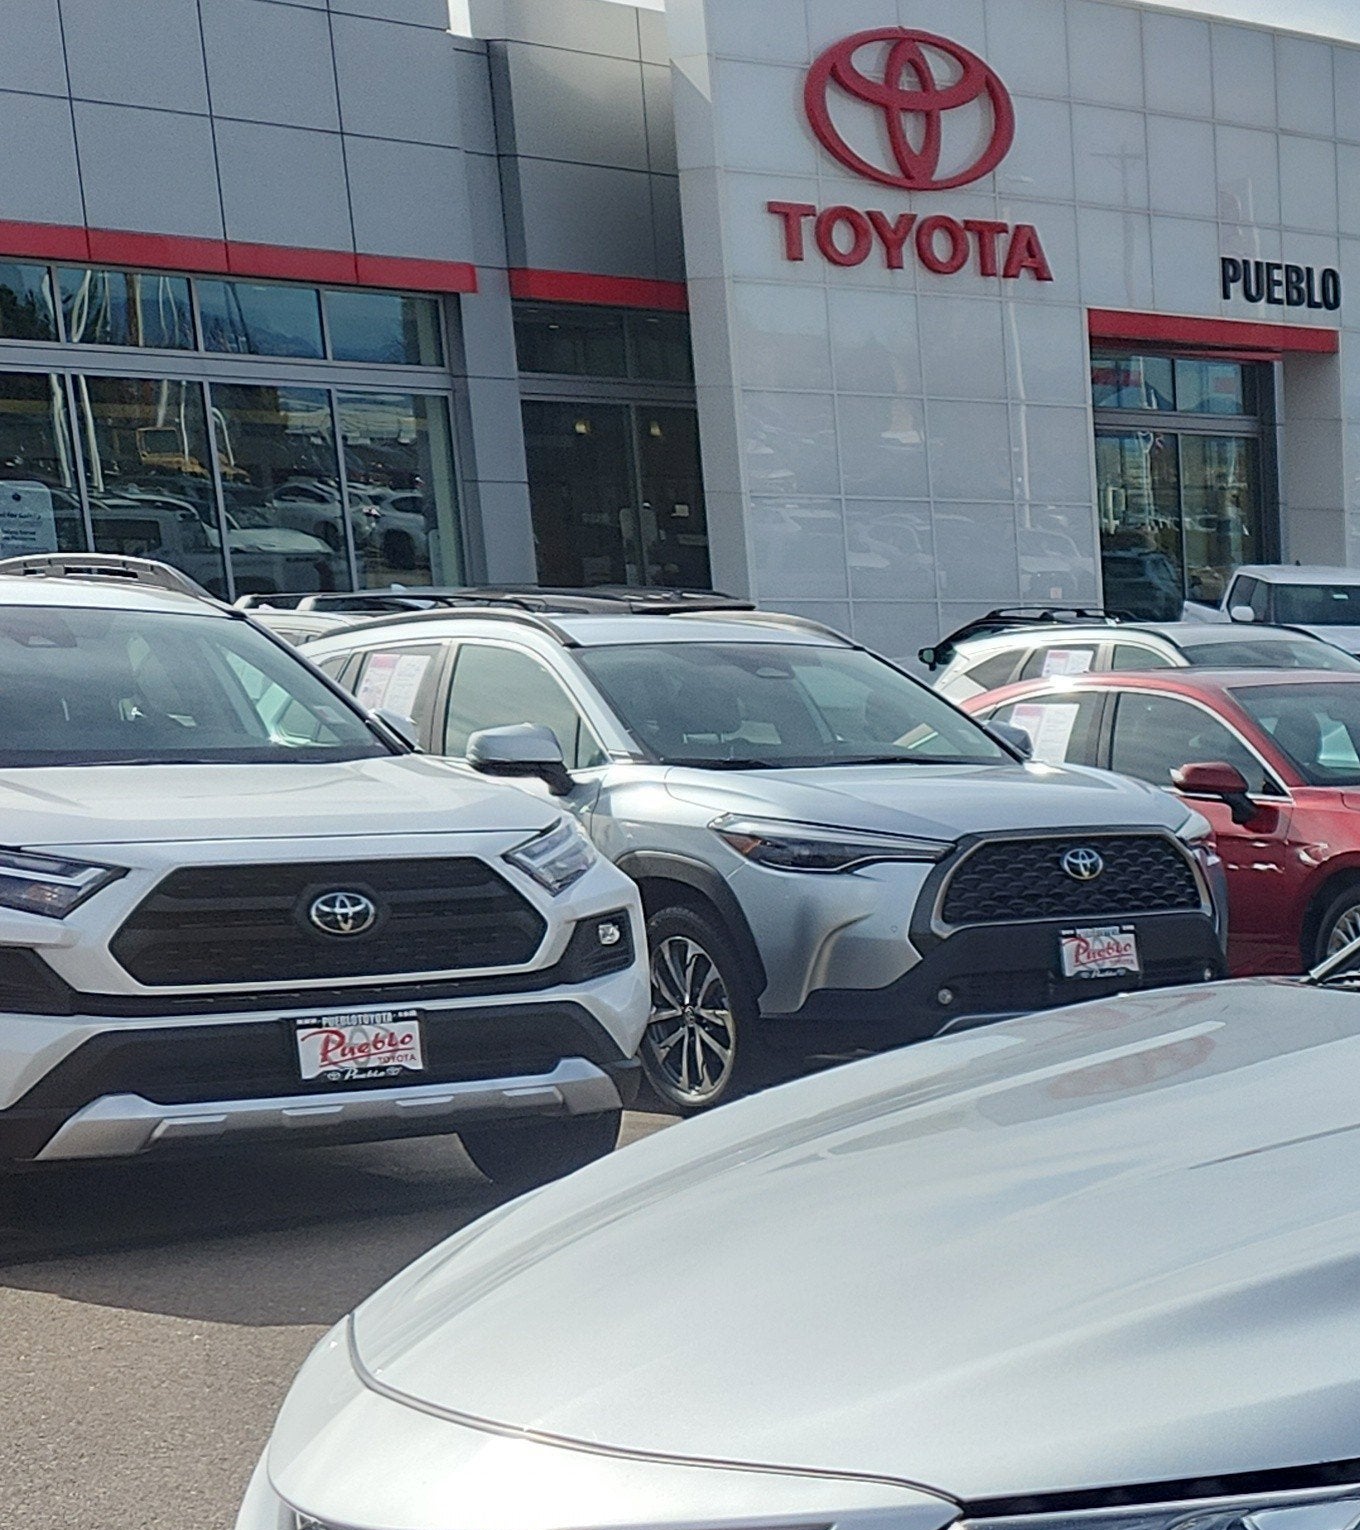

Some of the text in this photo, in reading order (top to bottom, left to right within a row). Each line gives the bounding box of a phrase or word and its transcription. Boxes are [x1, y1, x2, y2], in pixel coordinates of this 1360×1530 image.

[767, 201, 1054, 282] TOYOTA
[1220, 256, 1341, 311] PUEBLO
[1062, 936, 1131, 963] Pueblo
[300, 1029, 413, 1063] Pueblo
[377, 1053, 417, 1065] TOYOTA
